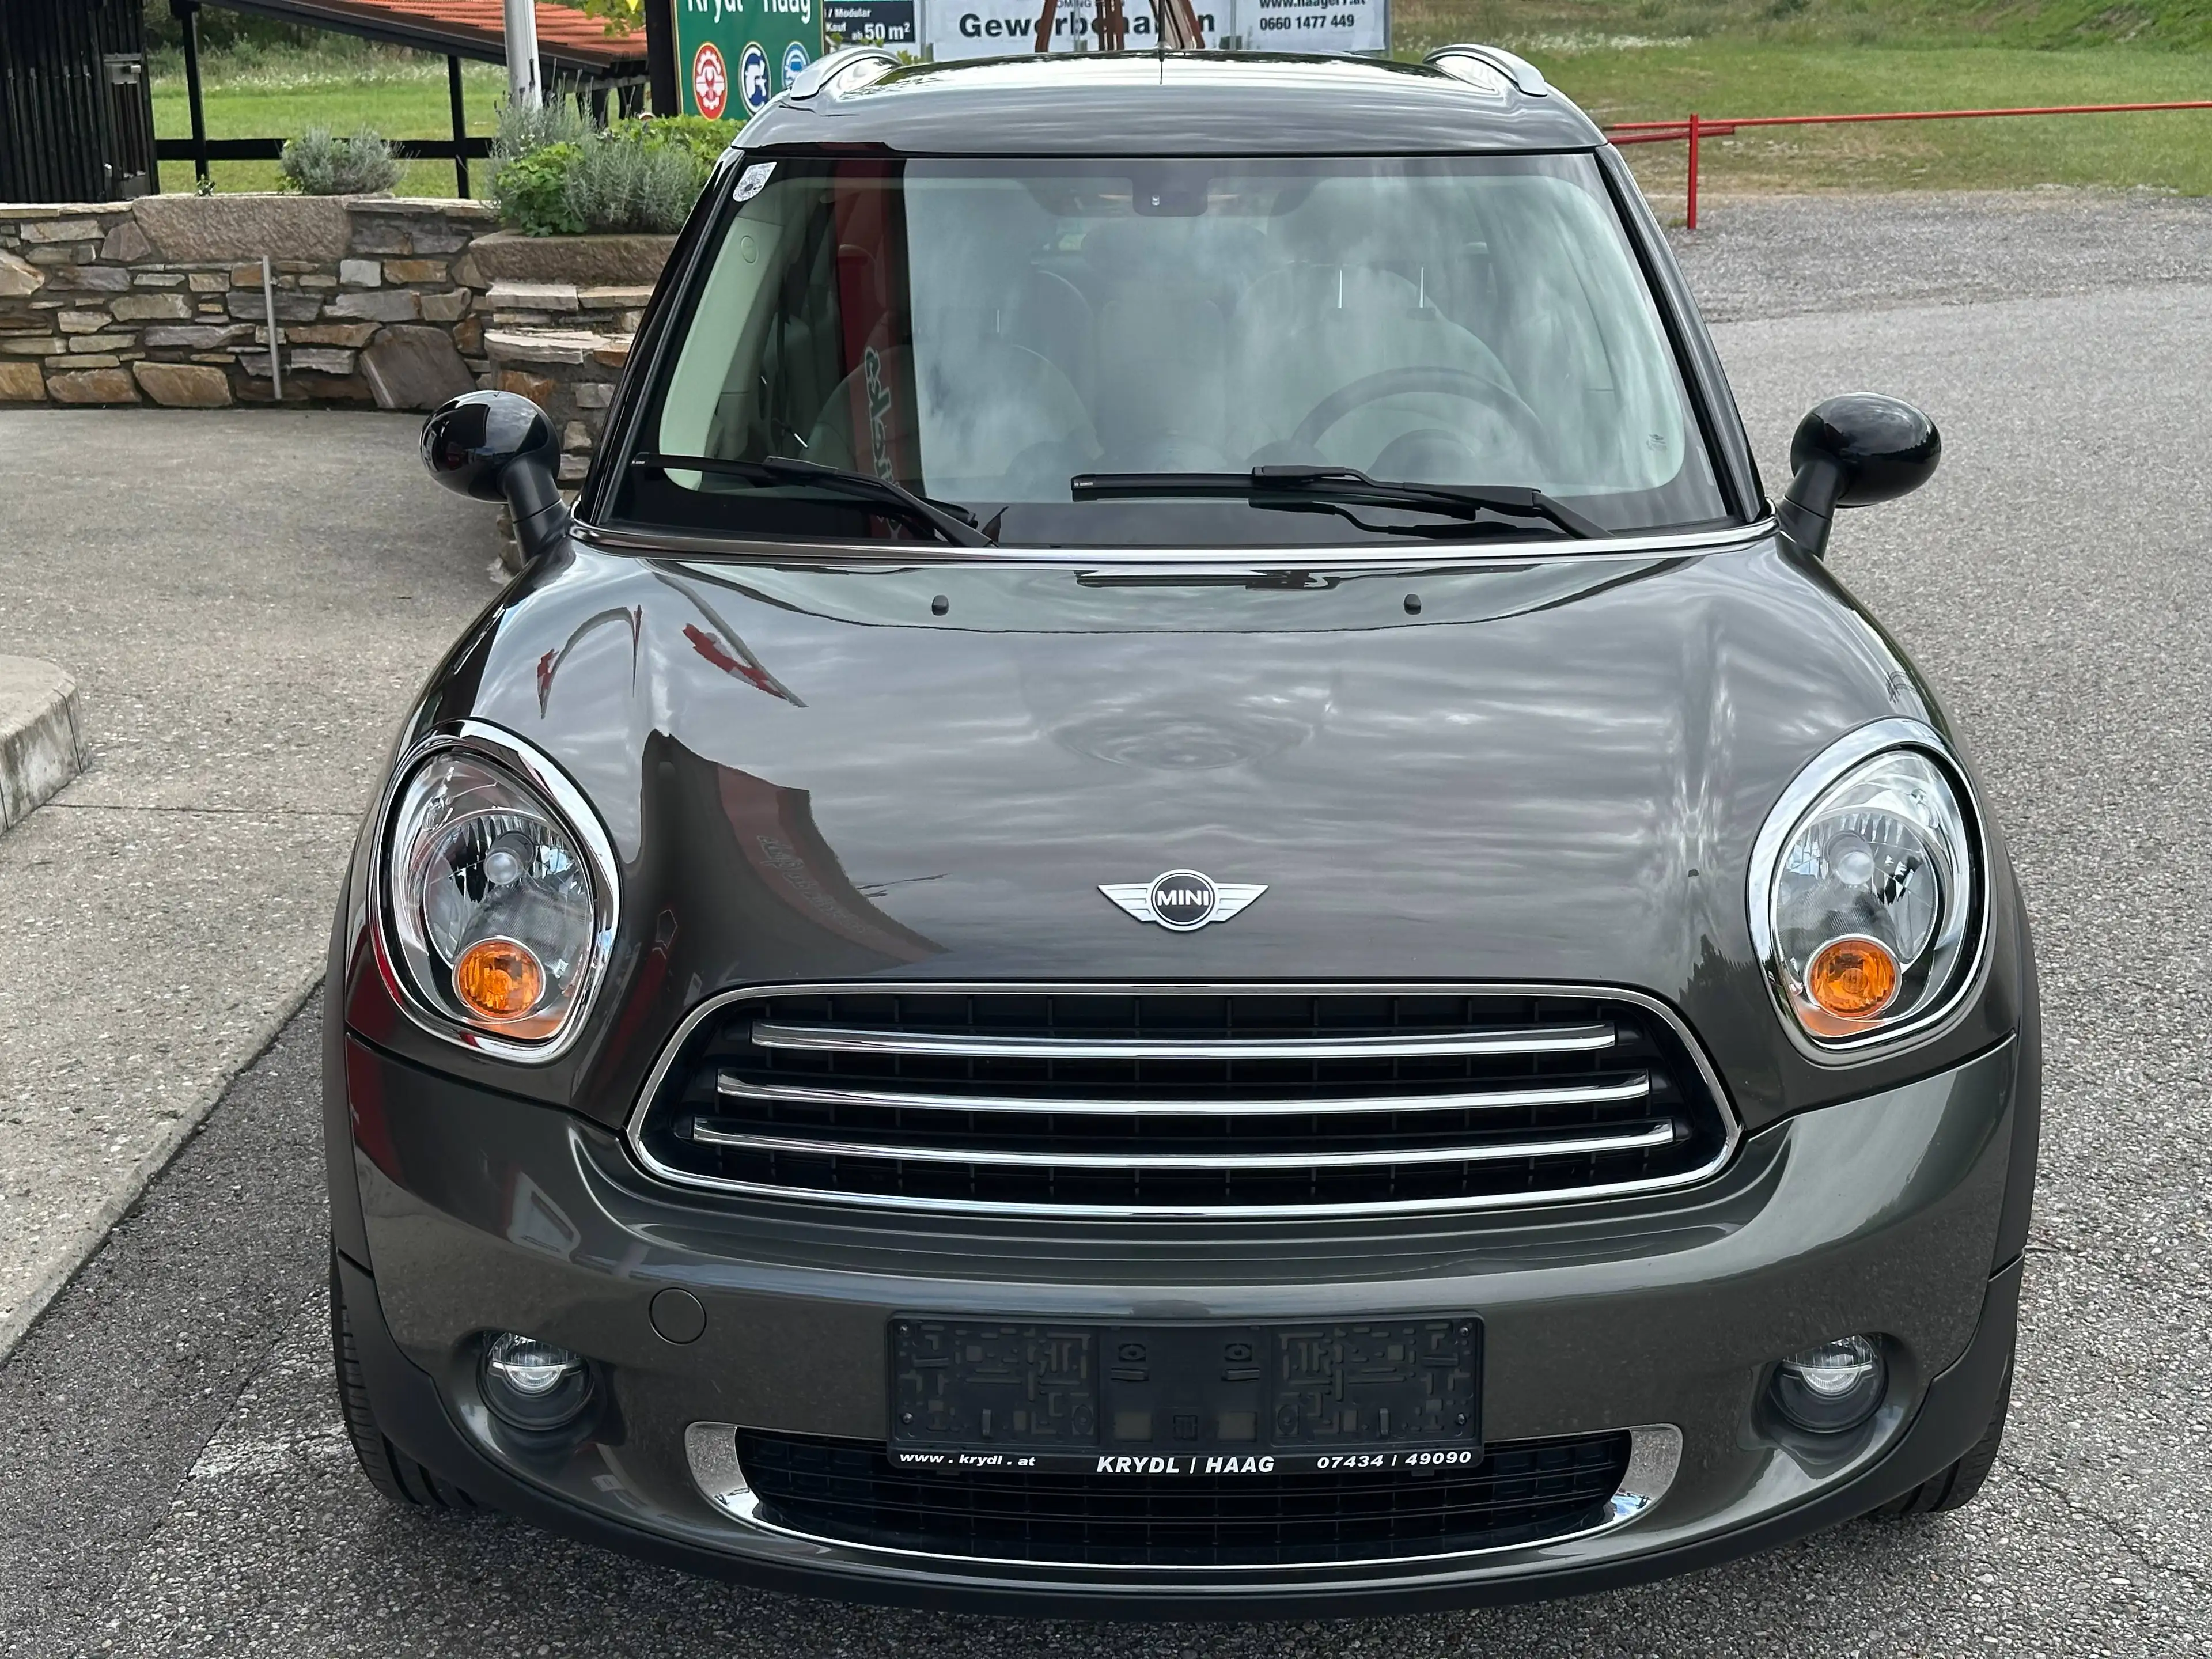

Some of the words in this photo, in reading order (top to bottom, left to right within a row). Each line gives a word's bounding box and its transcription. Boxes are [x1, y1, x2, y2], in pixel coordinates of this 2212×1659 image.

[835, 7, 872, 18] Modular
[825, 21, 847, 32] Kauf
[1260, 17, 1291, 30] 0660
[1296, 15, 1327, 29] 1477
[1331, 14, 1354, 28] 449
[851, 29, 863, 40] ab
[864, 22, 886, 40] 50
[1157, 889, 1210, 906] MINI
[1096, 1456, 1180, 1474] KRYDL
[1205, 1456, 1275, 1474] HAAG
[1317, 1455, 1384, 1469] 07434
[1404, 1450, 1472, 1466] 49090
